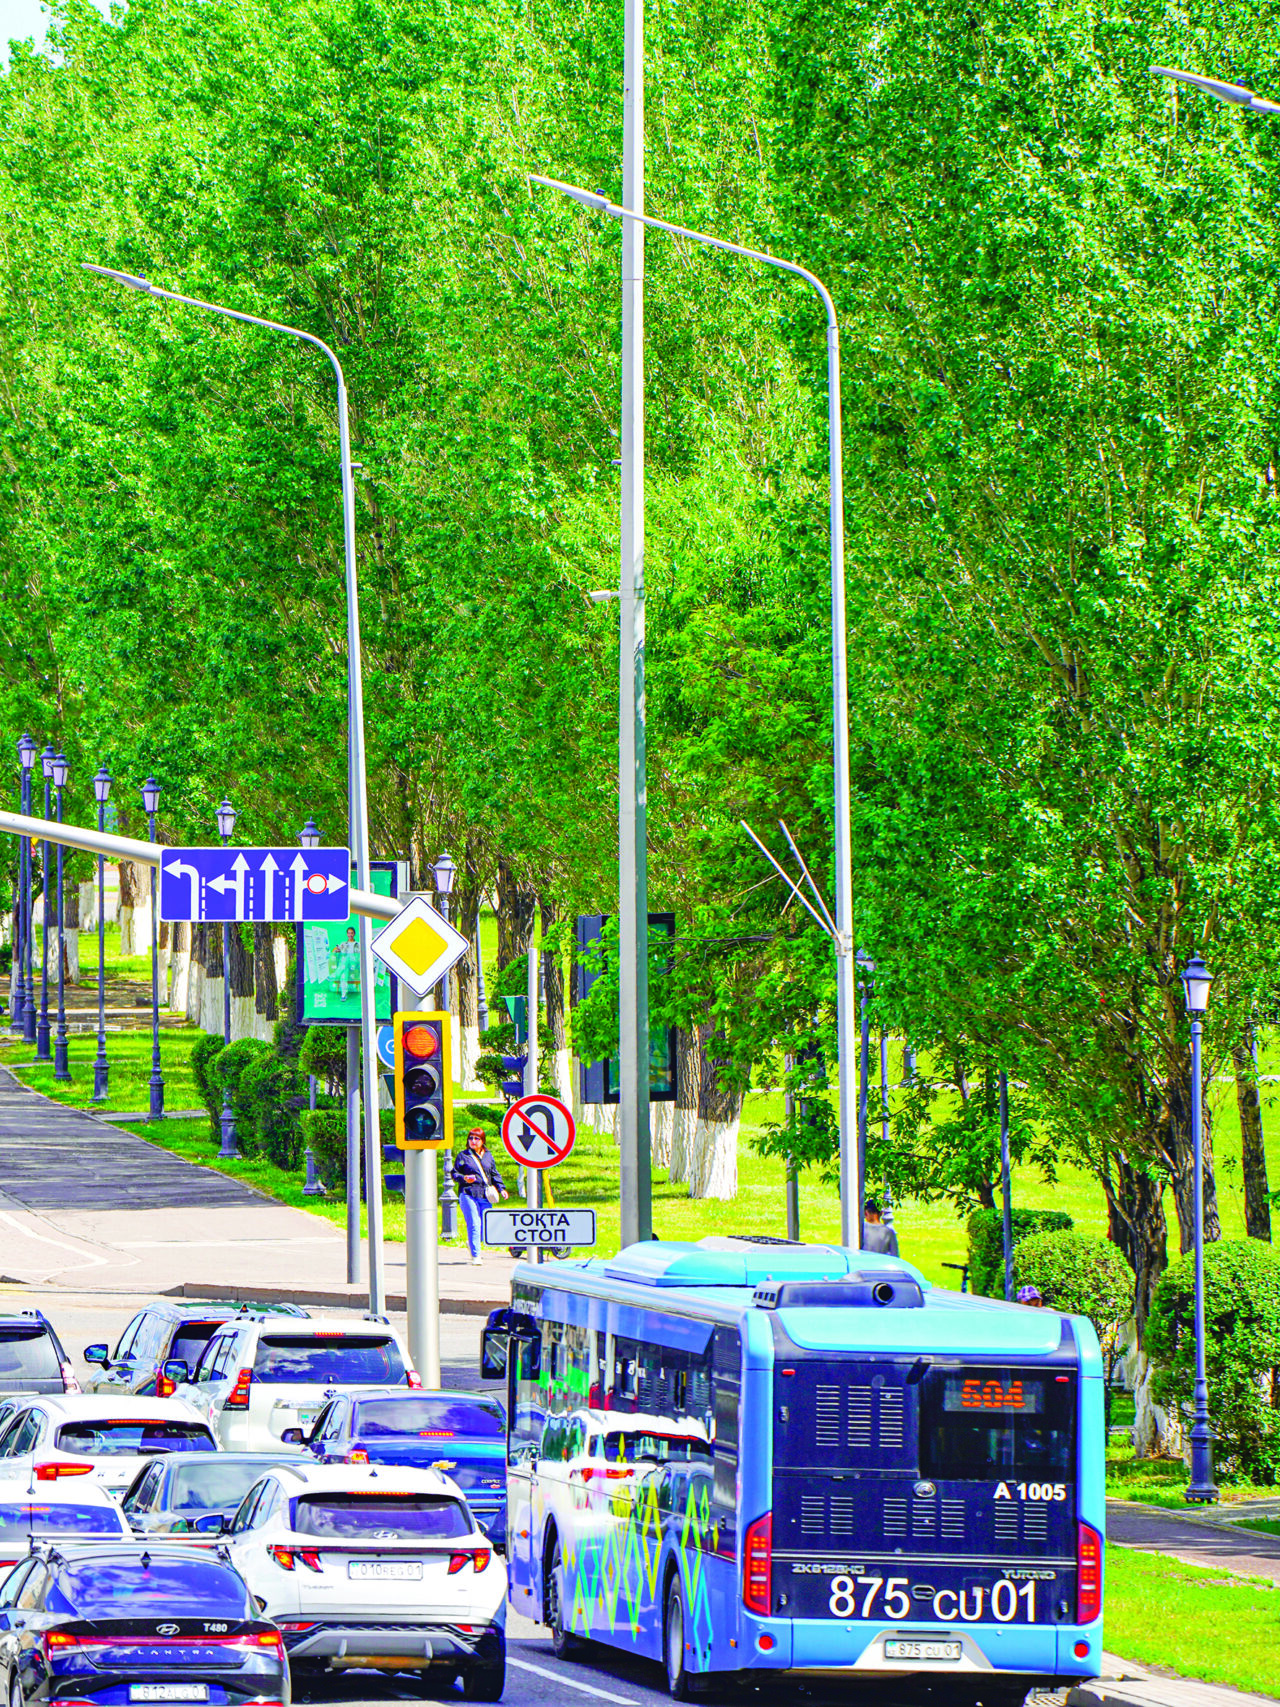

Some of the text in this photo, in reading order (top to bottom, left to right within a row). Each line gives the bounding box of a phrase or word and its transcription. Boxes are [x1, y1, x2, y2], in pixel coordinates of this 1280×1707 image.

[509, 1213, 570, 1228] ТОҚТА
[514, 1229, 566, 1242] СТОП
[993, 1482, 1067, 1501] A 1005
[1001, 1569, 1057, 1580] YUTONG
[828, 1575, 910, 1619] 875
[991, 1579, 1036, 1622] 01
[203, 1622, 228, 1632] T480
[898, 1643, 921, 1656] 875
[945, 1644, 960, 1656] 01
